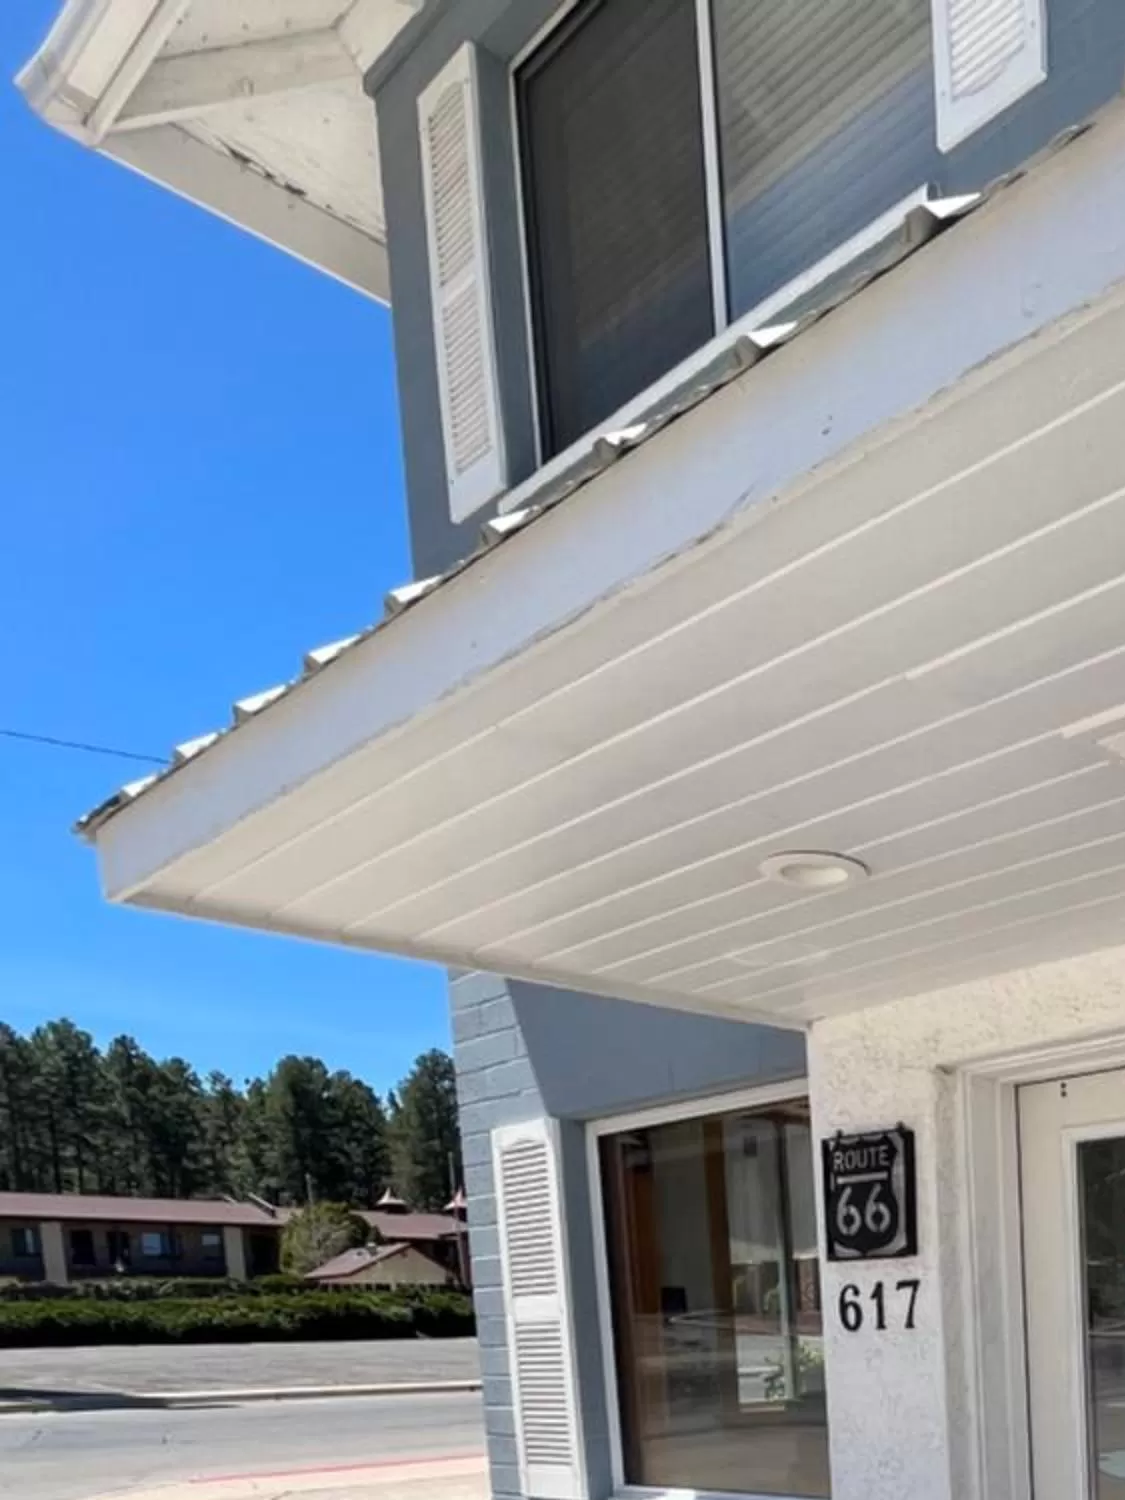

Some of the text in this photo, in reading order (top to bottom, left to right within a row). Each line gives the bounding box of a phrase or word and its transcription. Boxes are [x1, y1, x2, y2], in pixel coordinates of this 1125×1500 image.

[833, 1146, 891, 1172] ROUTE
[836, 1183, 891, 1236] 66
[839, 1279, 920, 1332] 617
